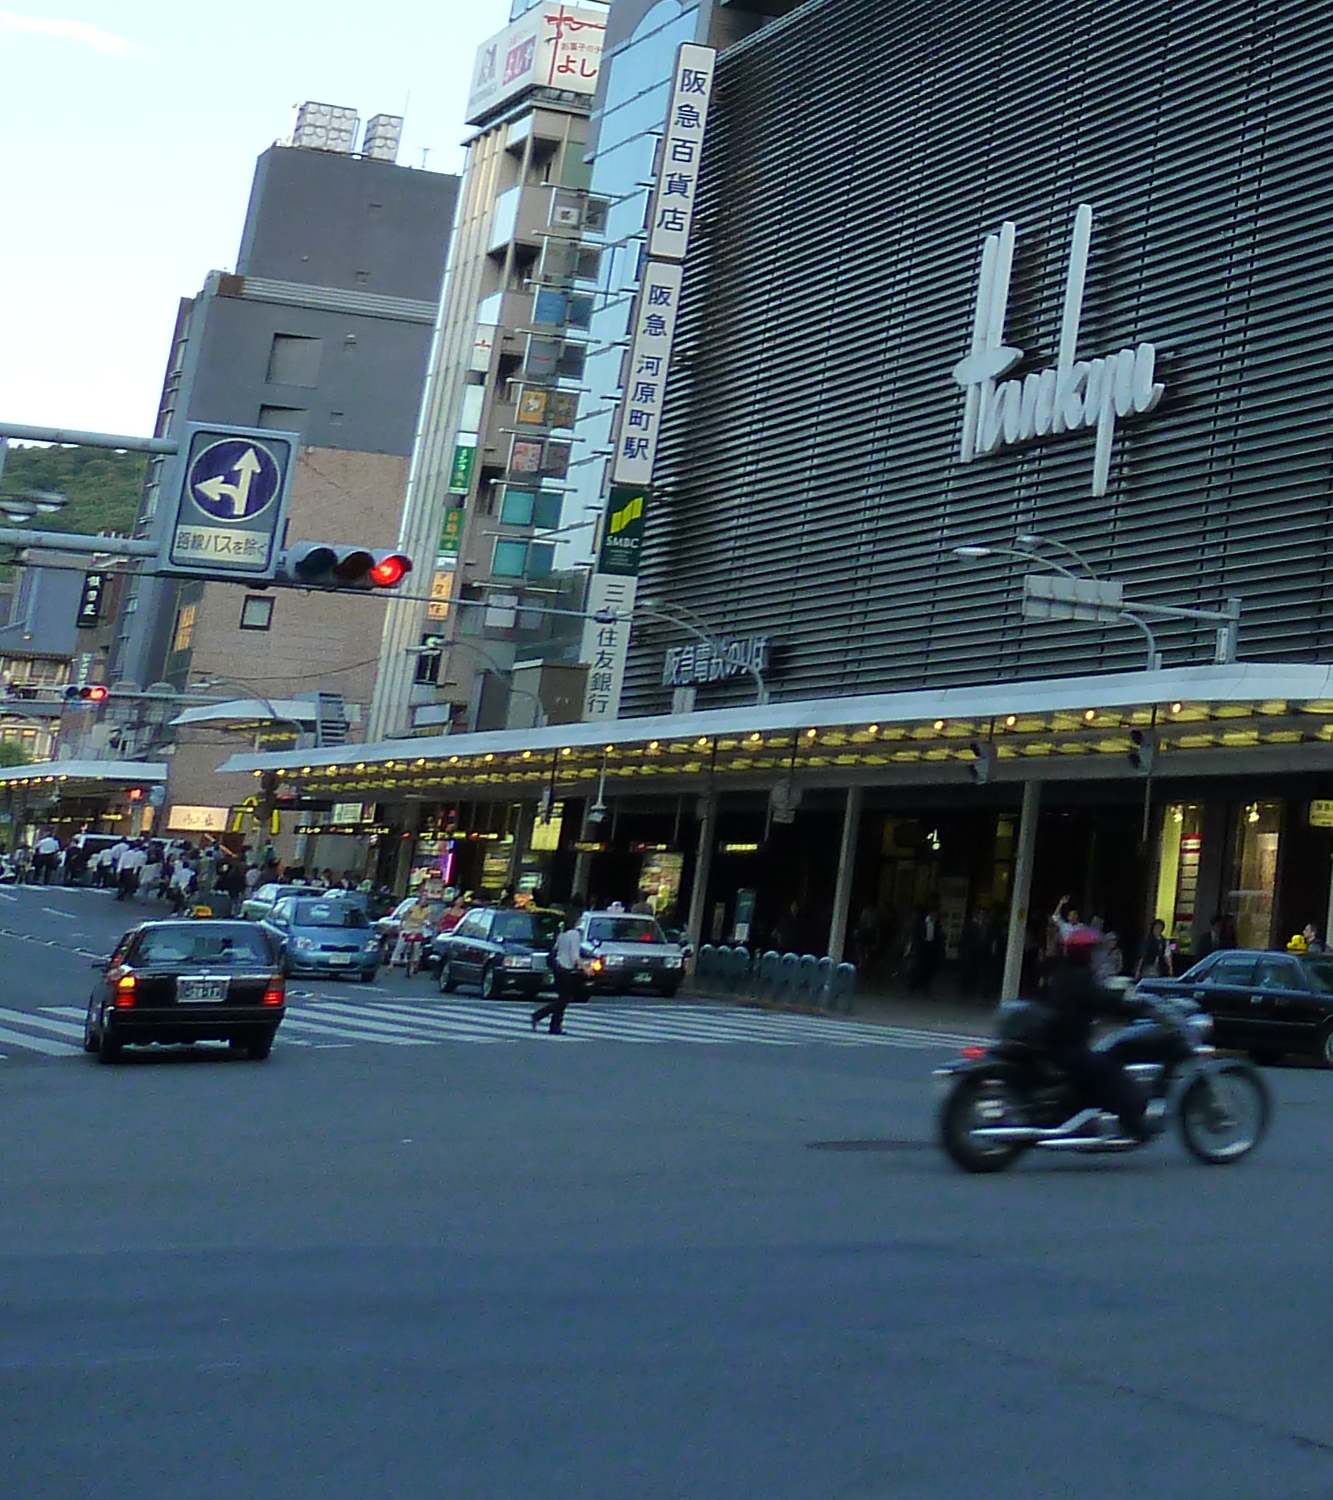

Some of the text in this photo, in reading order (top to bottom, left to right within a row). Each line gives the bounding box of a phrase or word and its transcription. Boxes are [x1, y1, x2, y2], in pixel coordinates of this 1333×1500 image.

[656, 67, 709, 234] 阪急百貨店
[952, 203, 1166, 498] Hankyu
[176, 530, 269, 559] 路線バスを除く
[605, 535, 640, 549] SMBC
